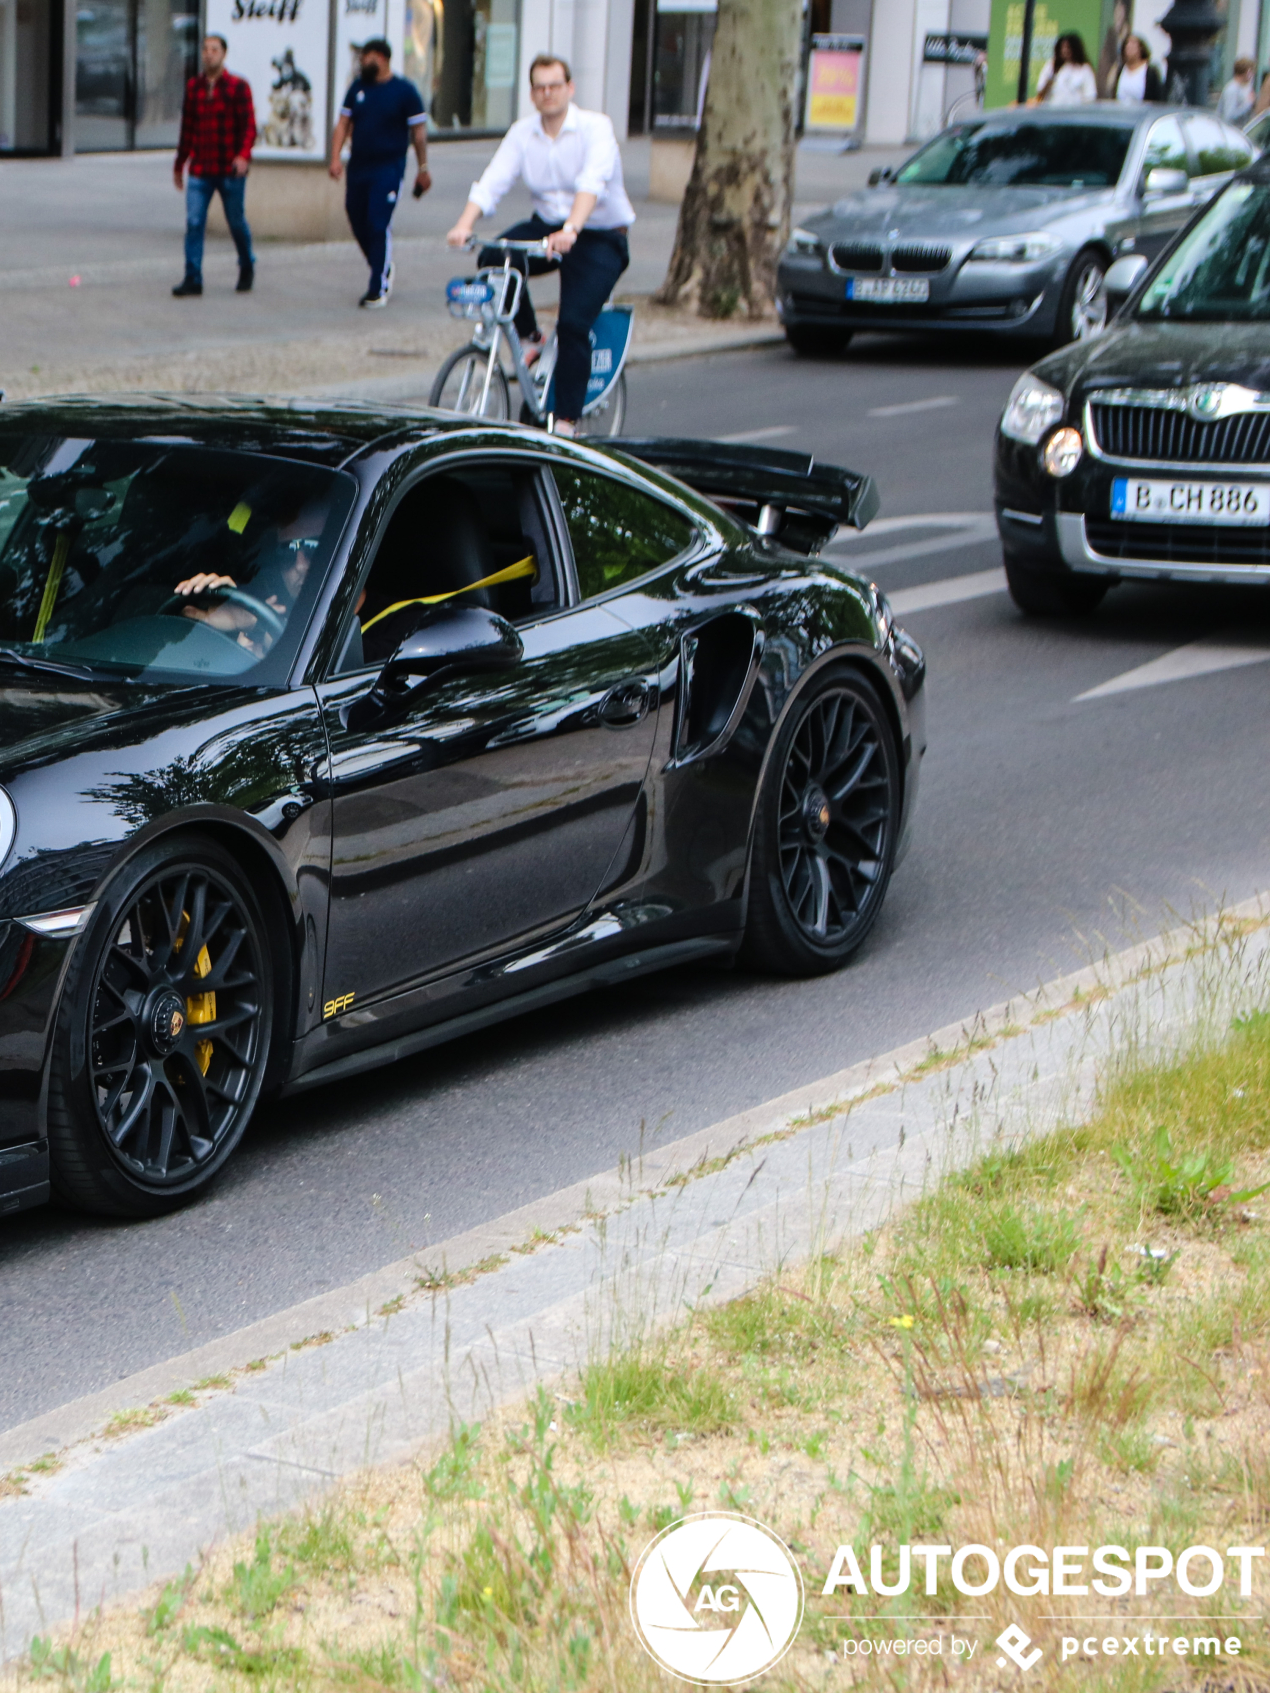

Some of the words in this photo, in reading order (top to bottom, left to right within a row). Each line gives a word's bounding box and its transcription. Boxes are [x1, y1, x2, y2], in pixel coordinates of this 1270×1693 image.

[591, 348, 612, 374] EZER
[1136, 485, 1151, 509] B
[1210, 487, 1258, 513] 886
